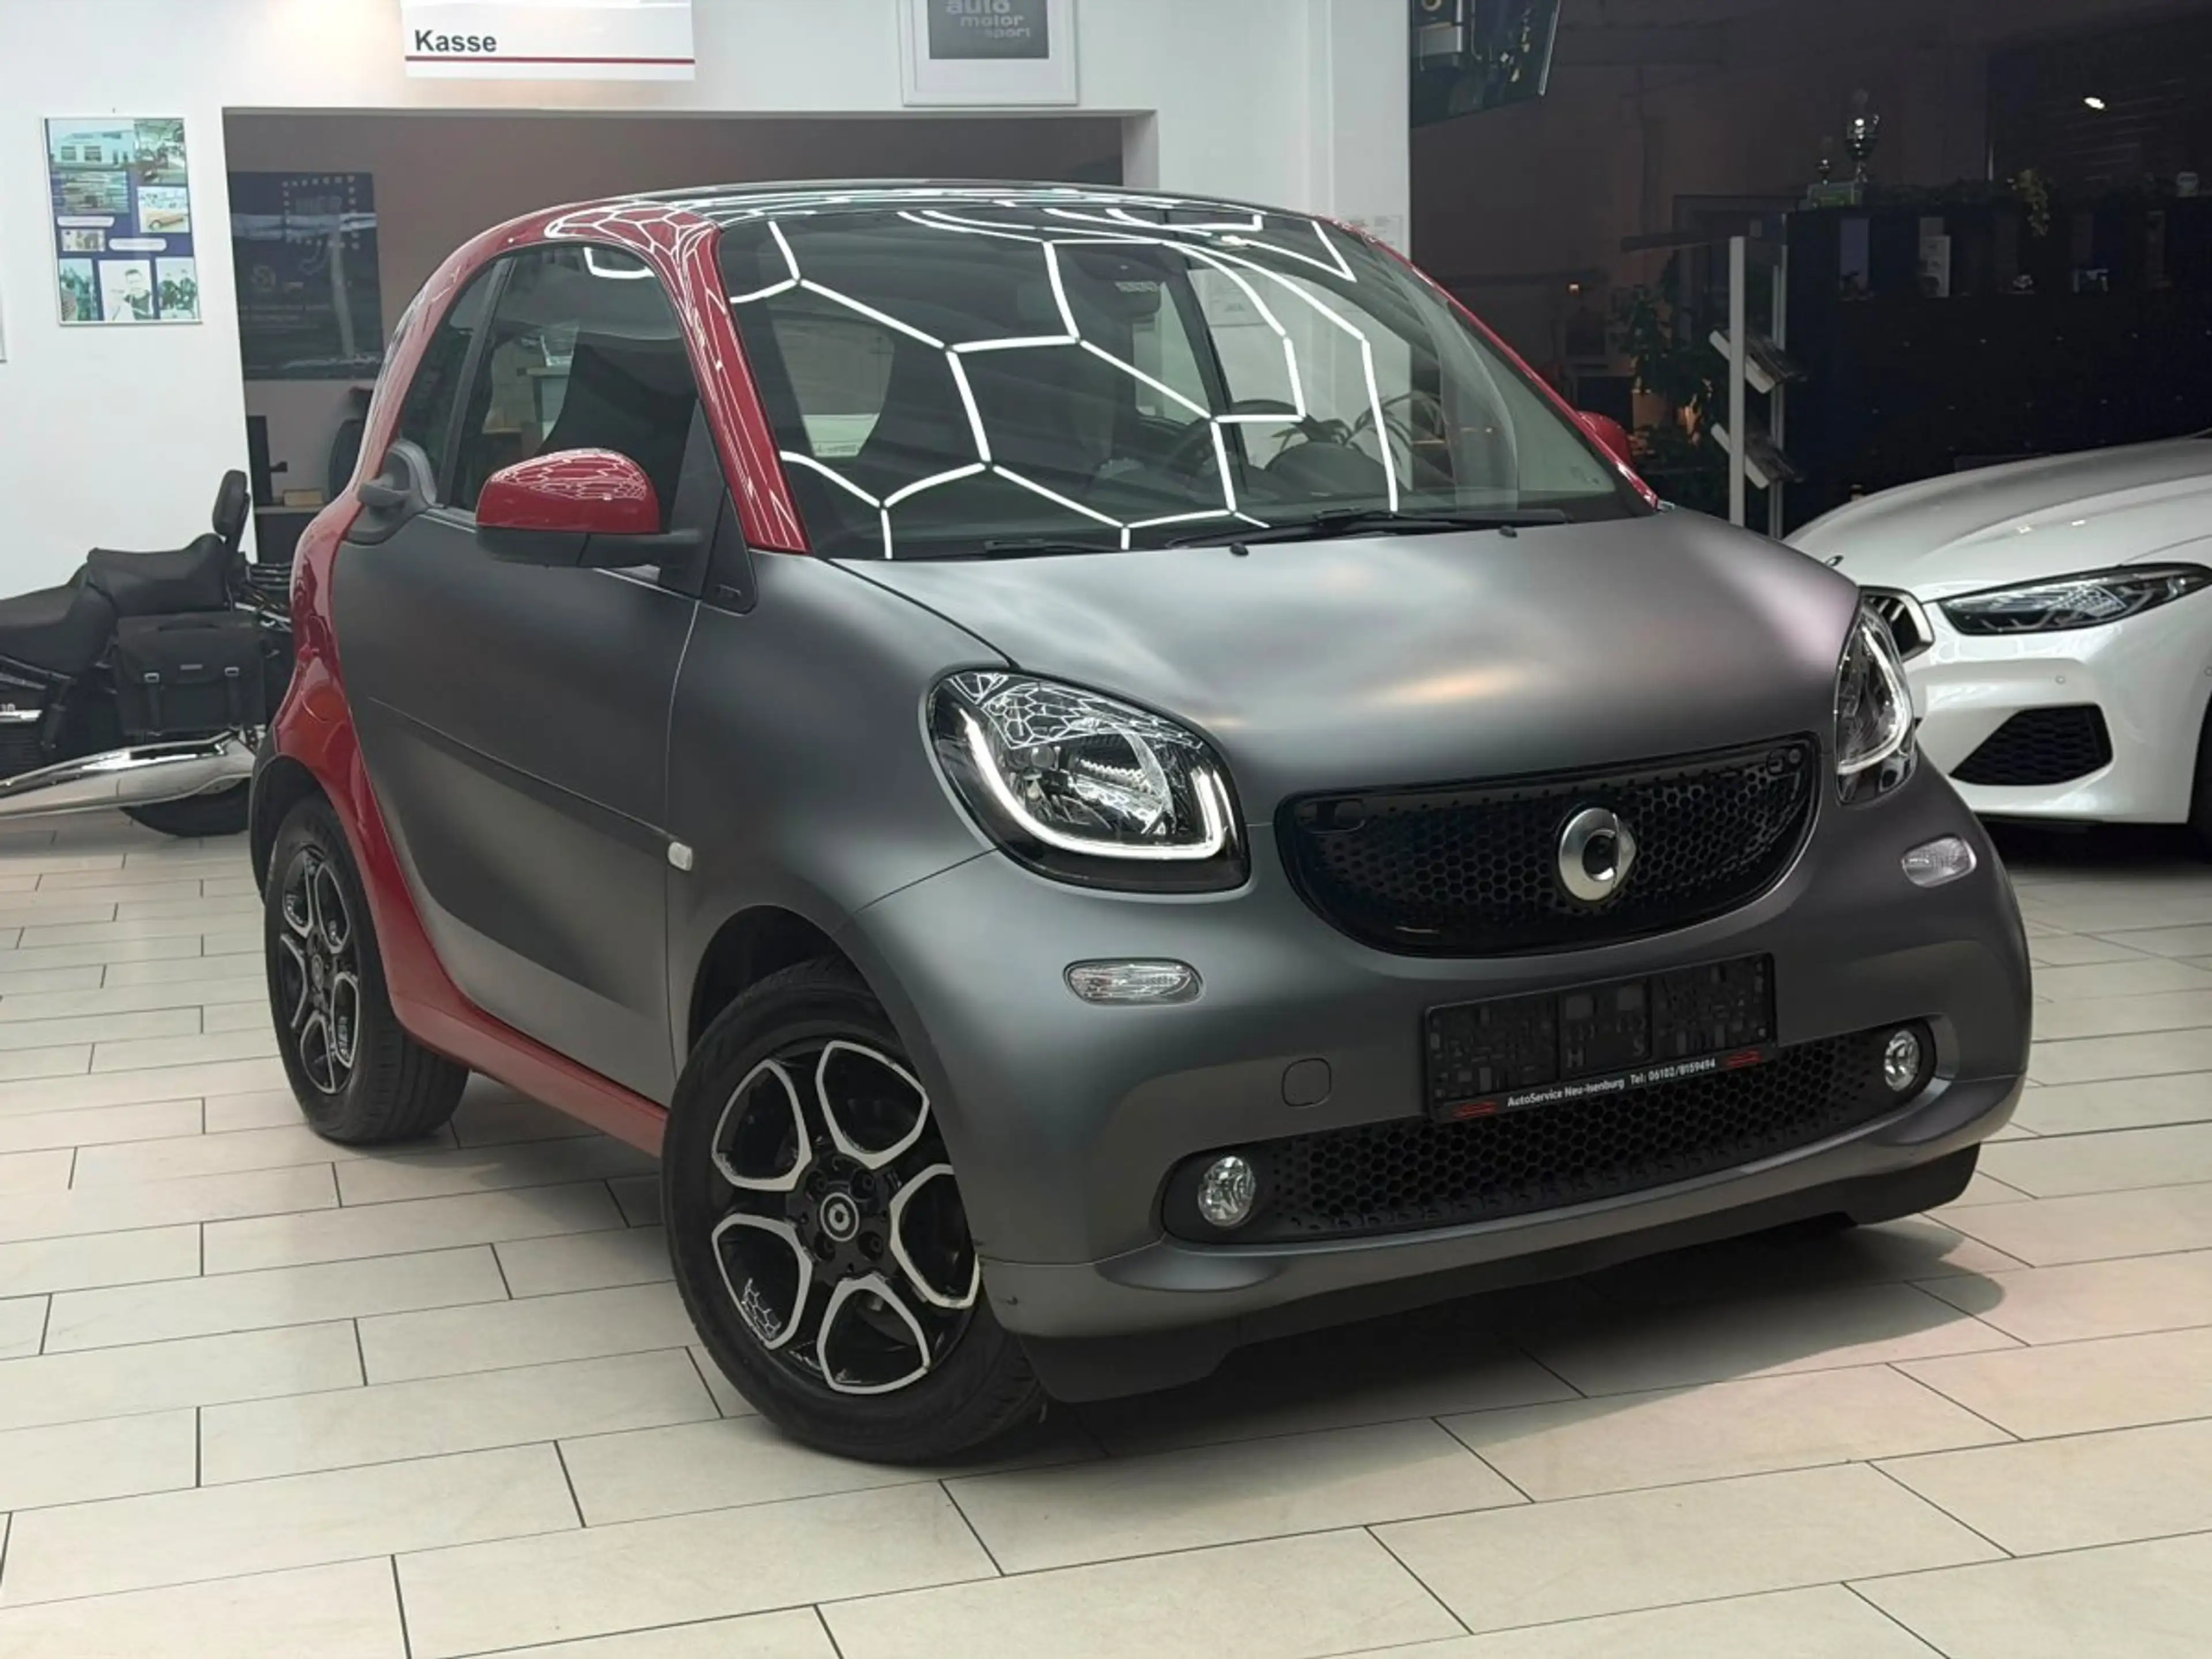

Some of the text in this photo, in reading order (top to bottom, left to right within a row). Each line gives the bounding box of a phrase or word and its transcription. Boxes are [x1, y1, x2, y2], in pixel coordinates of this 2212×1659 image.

[945, 0, 1010, 14] auto
[960, 15, 1025, 28] motor
[414, 29, 497, 52] Kasse
[1507, 1088, 1563, 1107] AutoService
